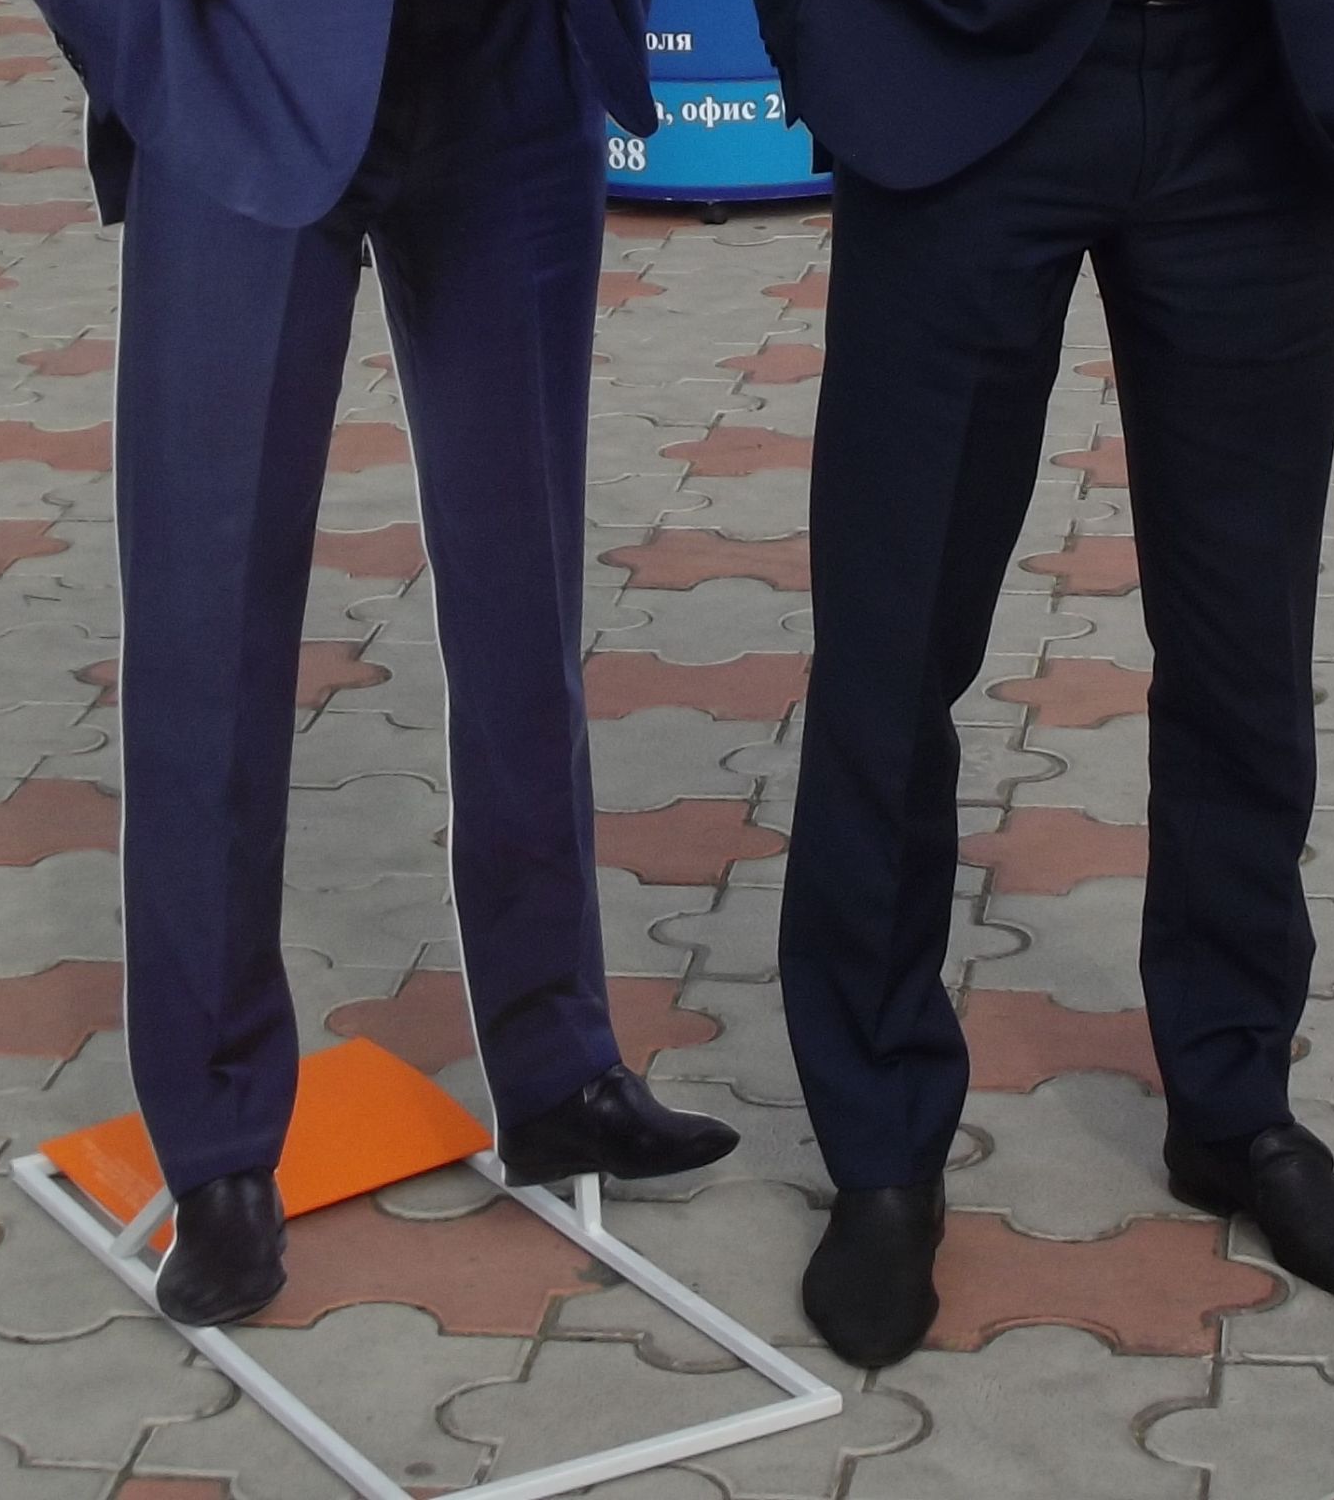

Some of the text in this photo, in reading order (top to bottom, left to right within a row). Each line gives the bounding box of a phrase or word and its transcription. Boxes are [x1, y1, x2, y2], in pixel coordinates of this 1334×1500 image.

[681, 97, 757, 128] офис
[765, 94, 785, 119] 2
[607, 136, 647, 171] 88
